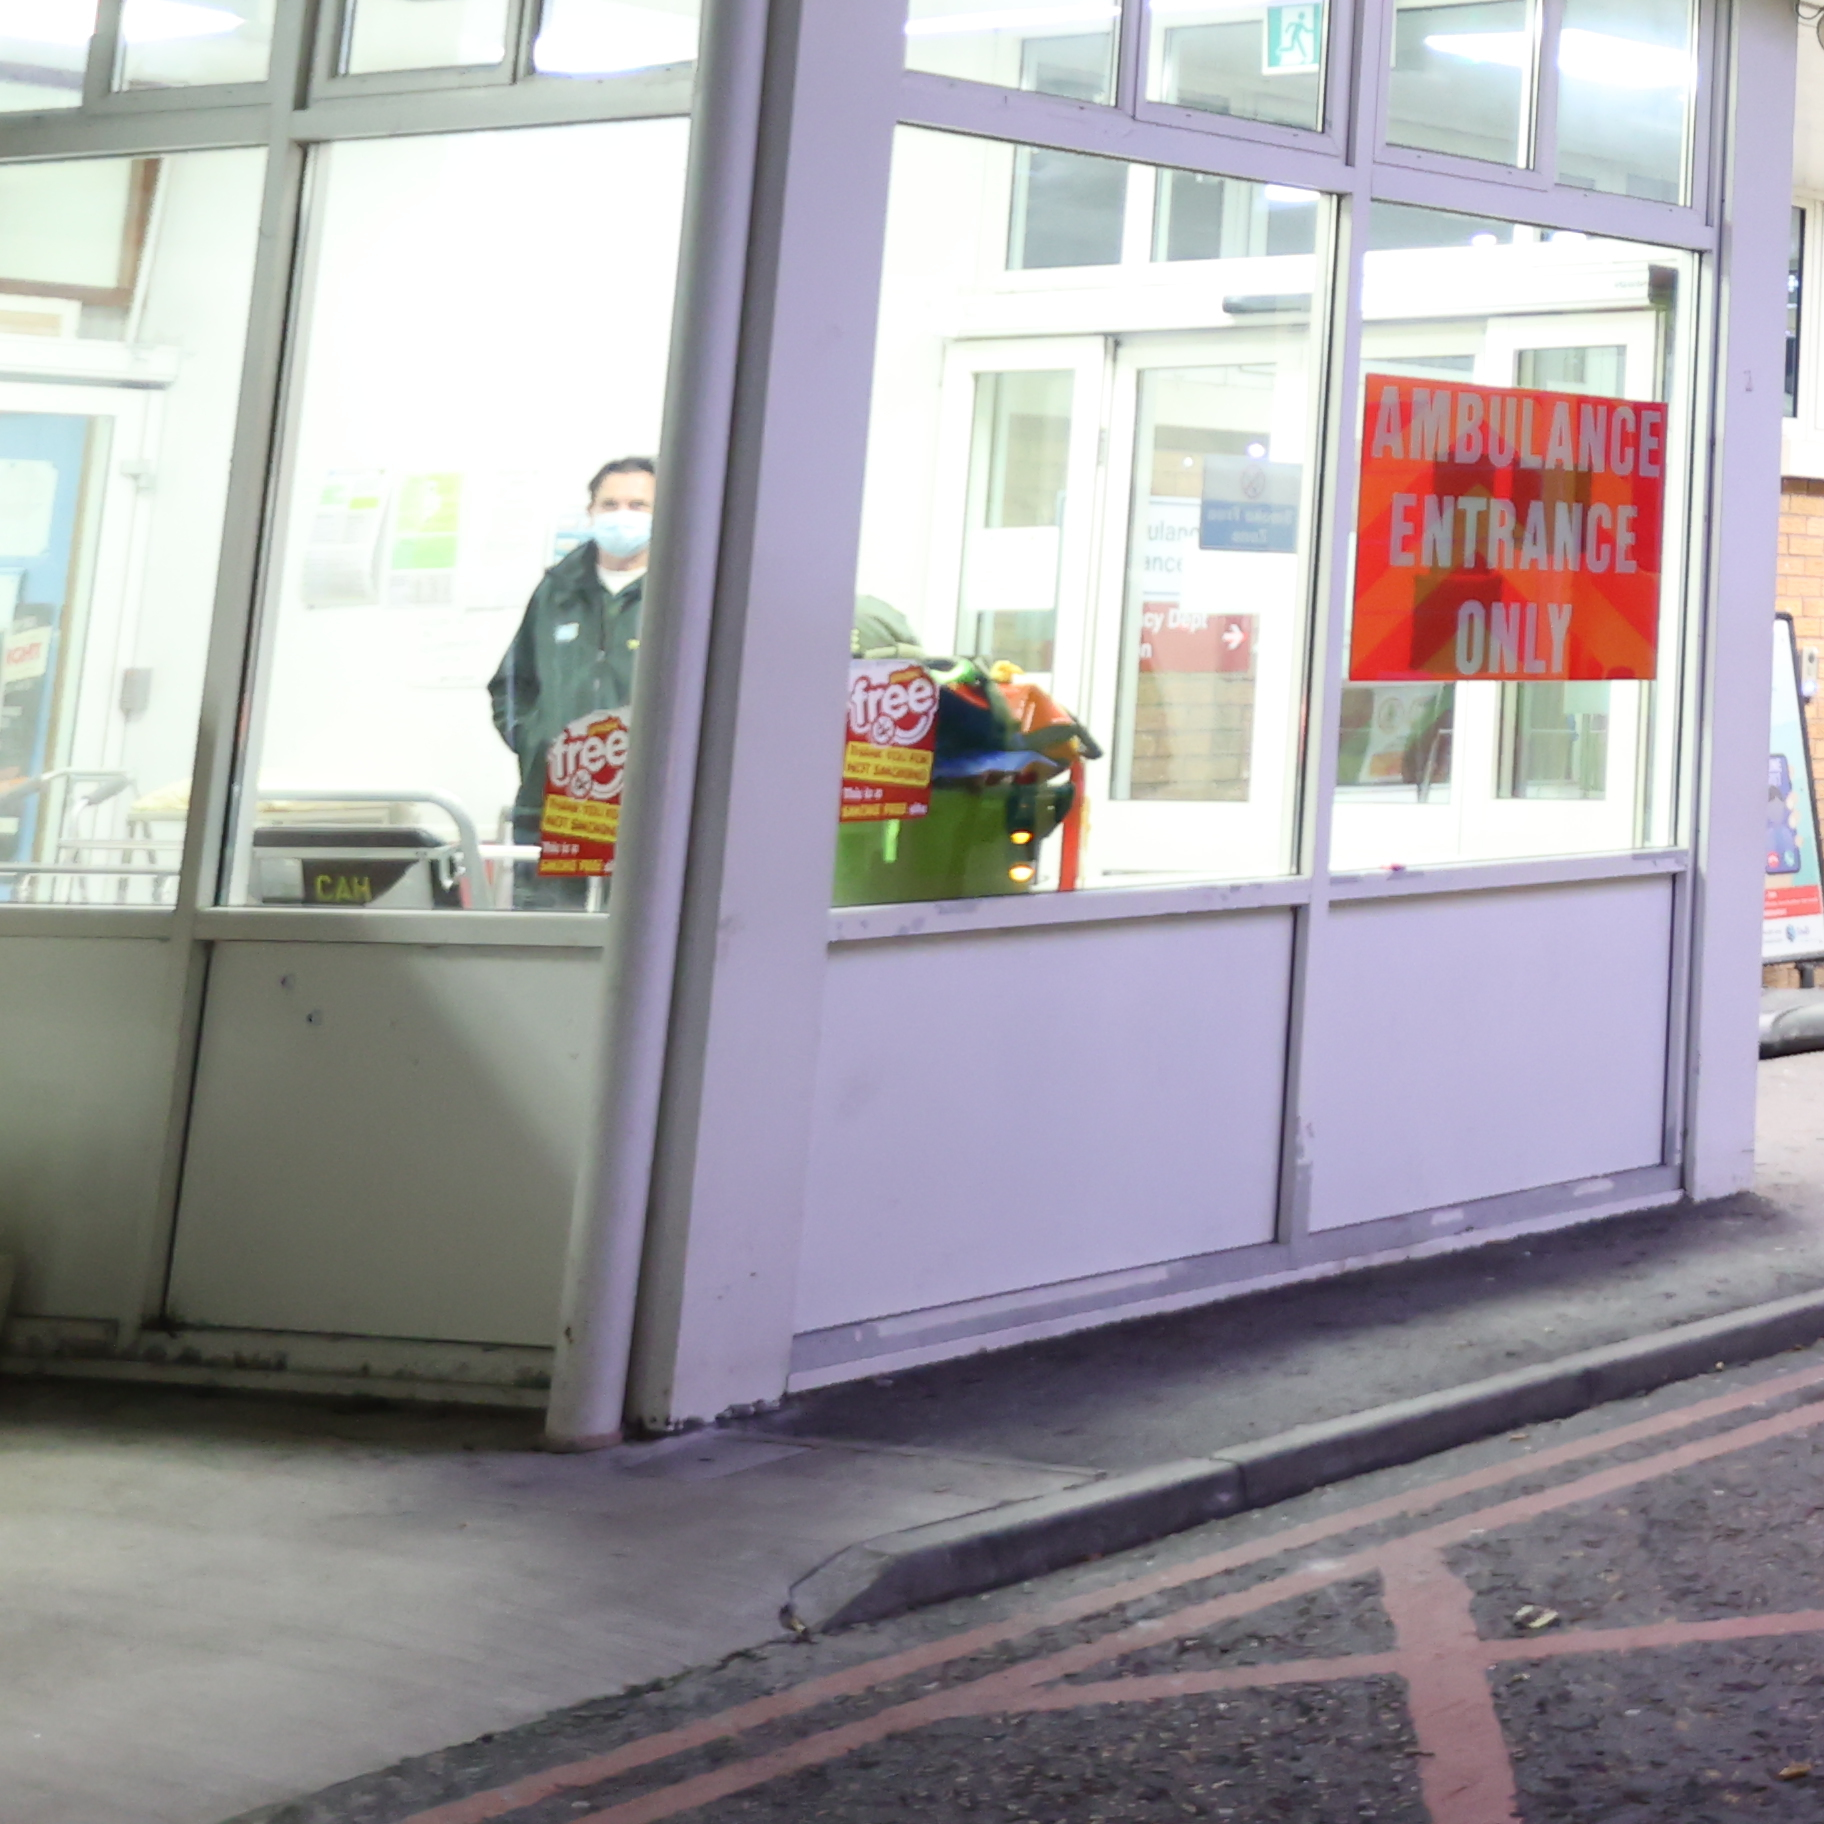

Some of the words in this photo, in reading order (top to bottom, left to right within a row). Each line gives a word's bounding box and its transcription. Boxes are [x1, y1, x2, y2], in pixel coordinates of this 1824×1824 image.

[1371, 385, 1662, 478] AMBULANCE
[1389, 492, 1638, 574] ENTRANCE
[1455, 598, 1573, 676] ONLY
[852, 678, 934, 732] free
[551, 729, 629, 785] free
[314, 874, 373, 903] CAH
